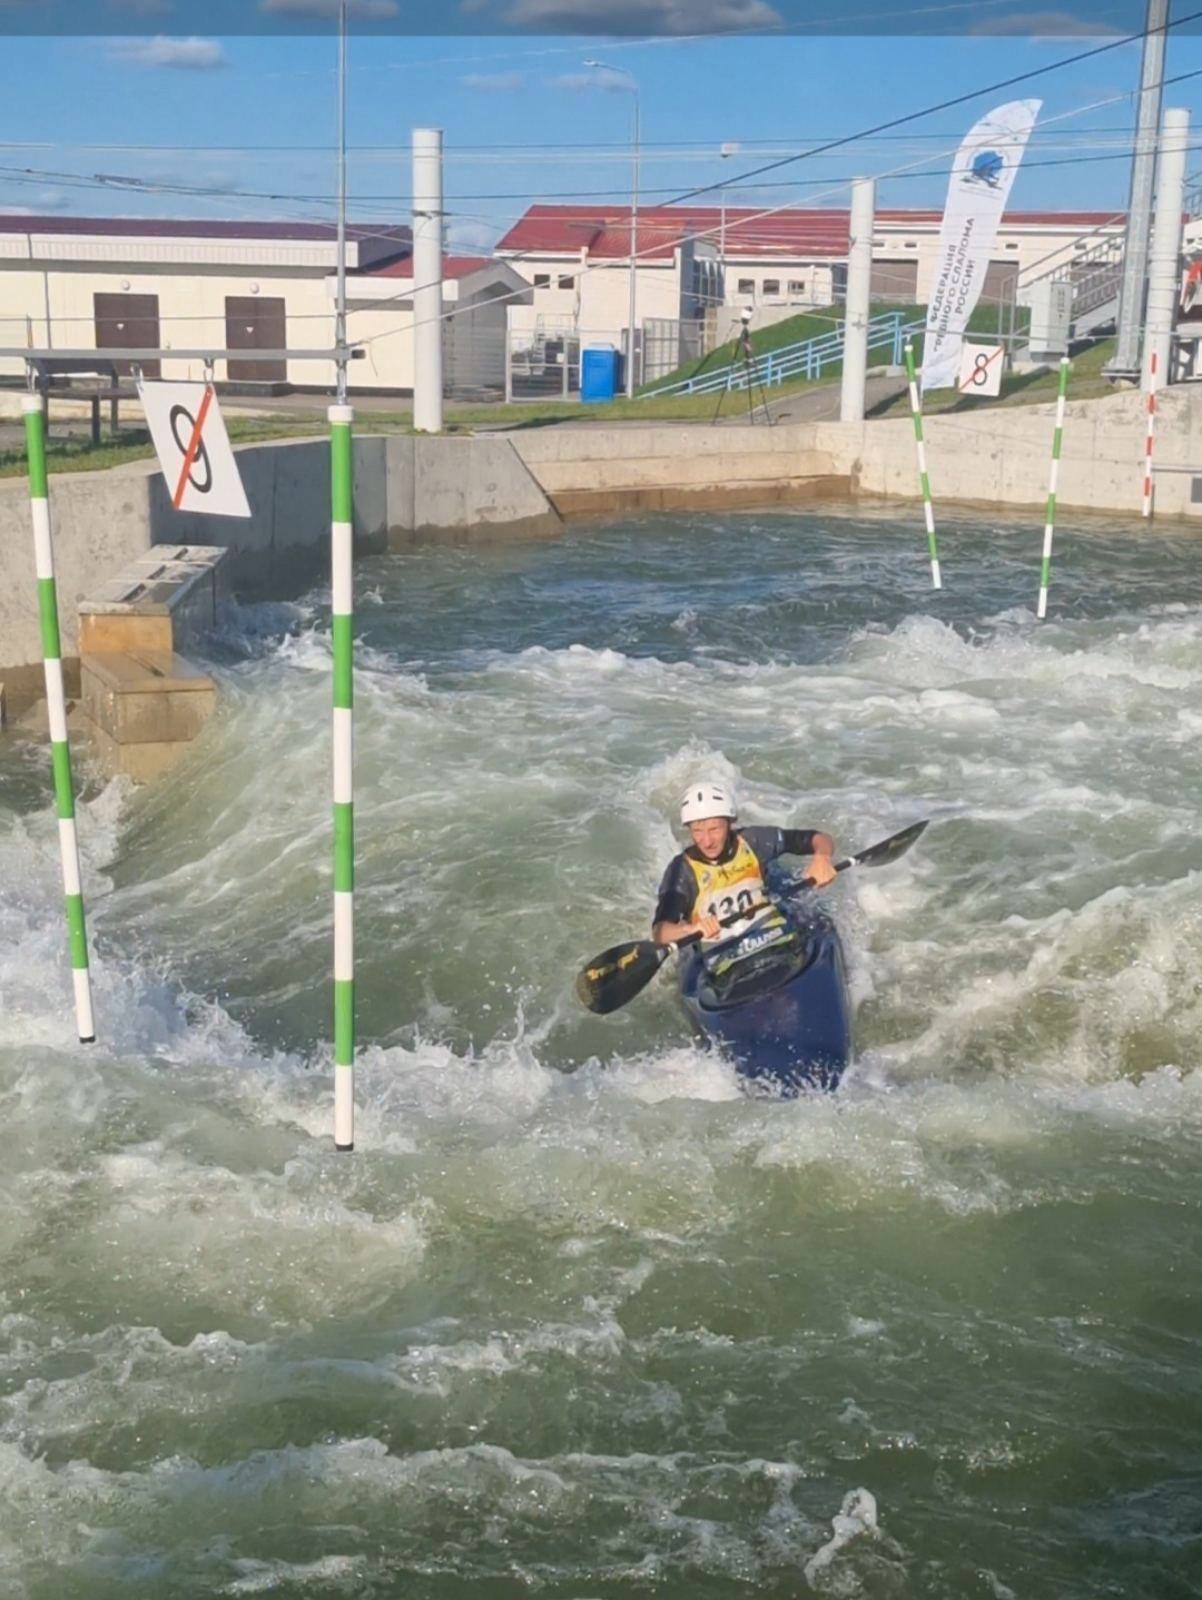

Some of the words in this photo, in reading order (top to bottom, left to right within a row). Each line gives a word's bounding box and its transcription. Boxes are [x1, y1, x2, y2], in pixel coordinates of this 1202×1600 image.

[930, 244, 957, 323] ФЕДЕРАЦИЯ
[951, 217, 976, 285] СЛАЛОМА
[955, 259, 976, 315] РОССИИ
[973, 353, 988, 386] 8
[169, 404, 213, 494] 9
